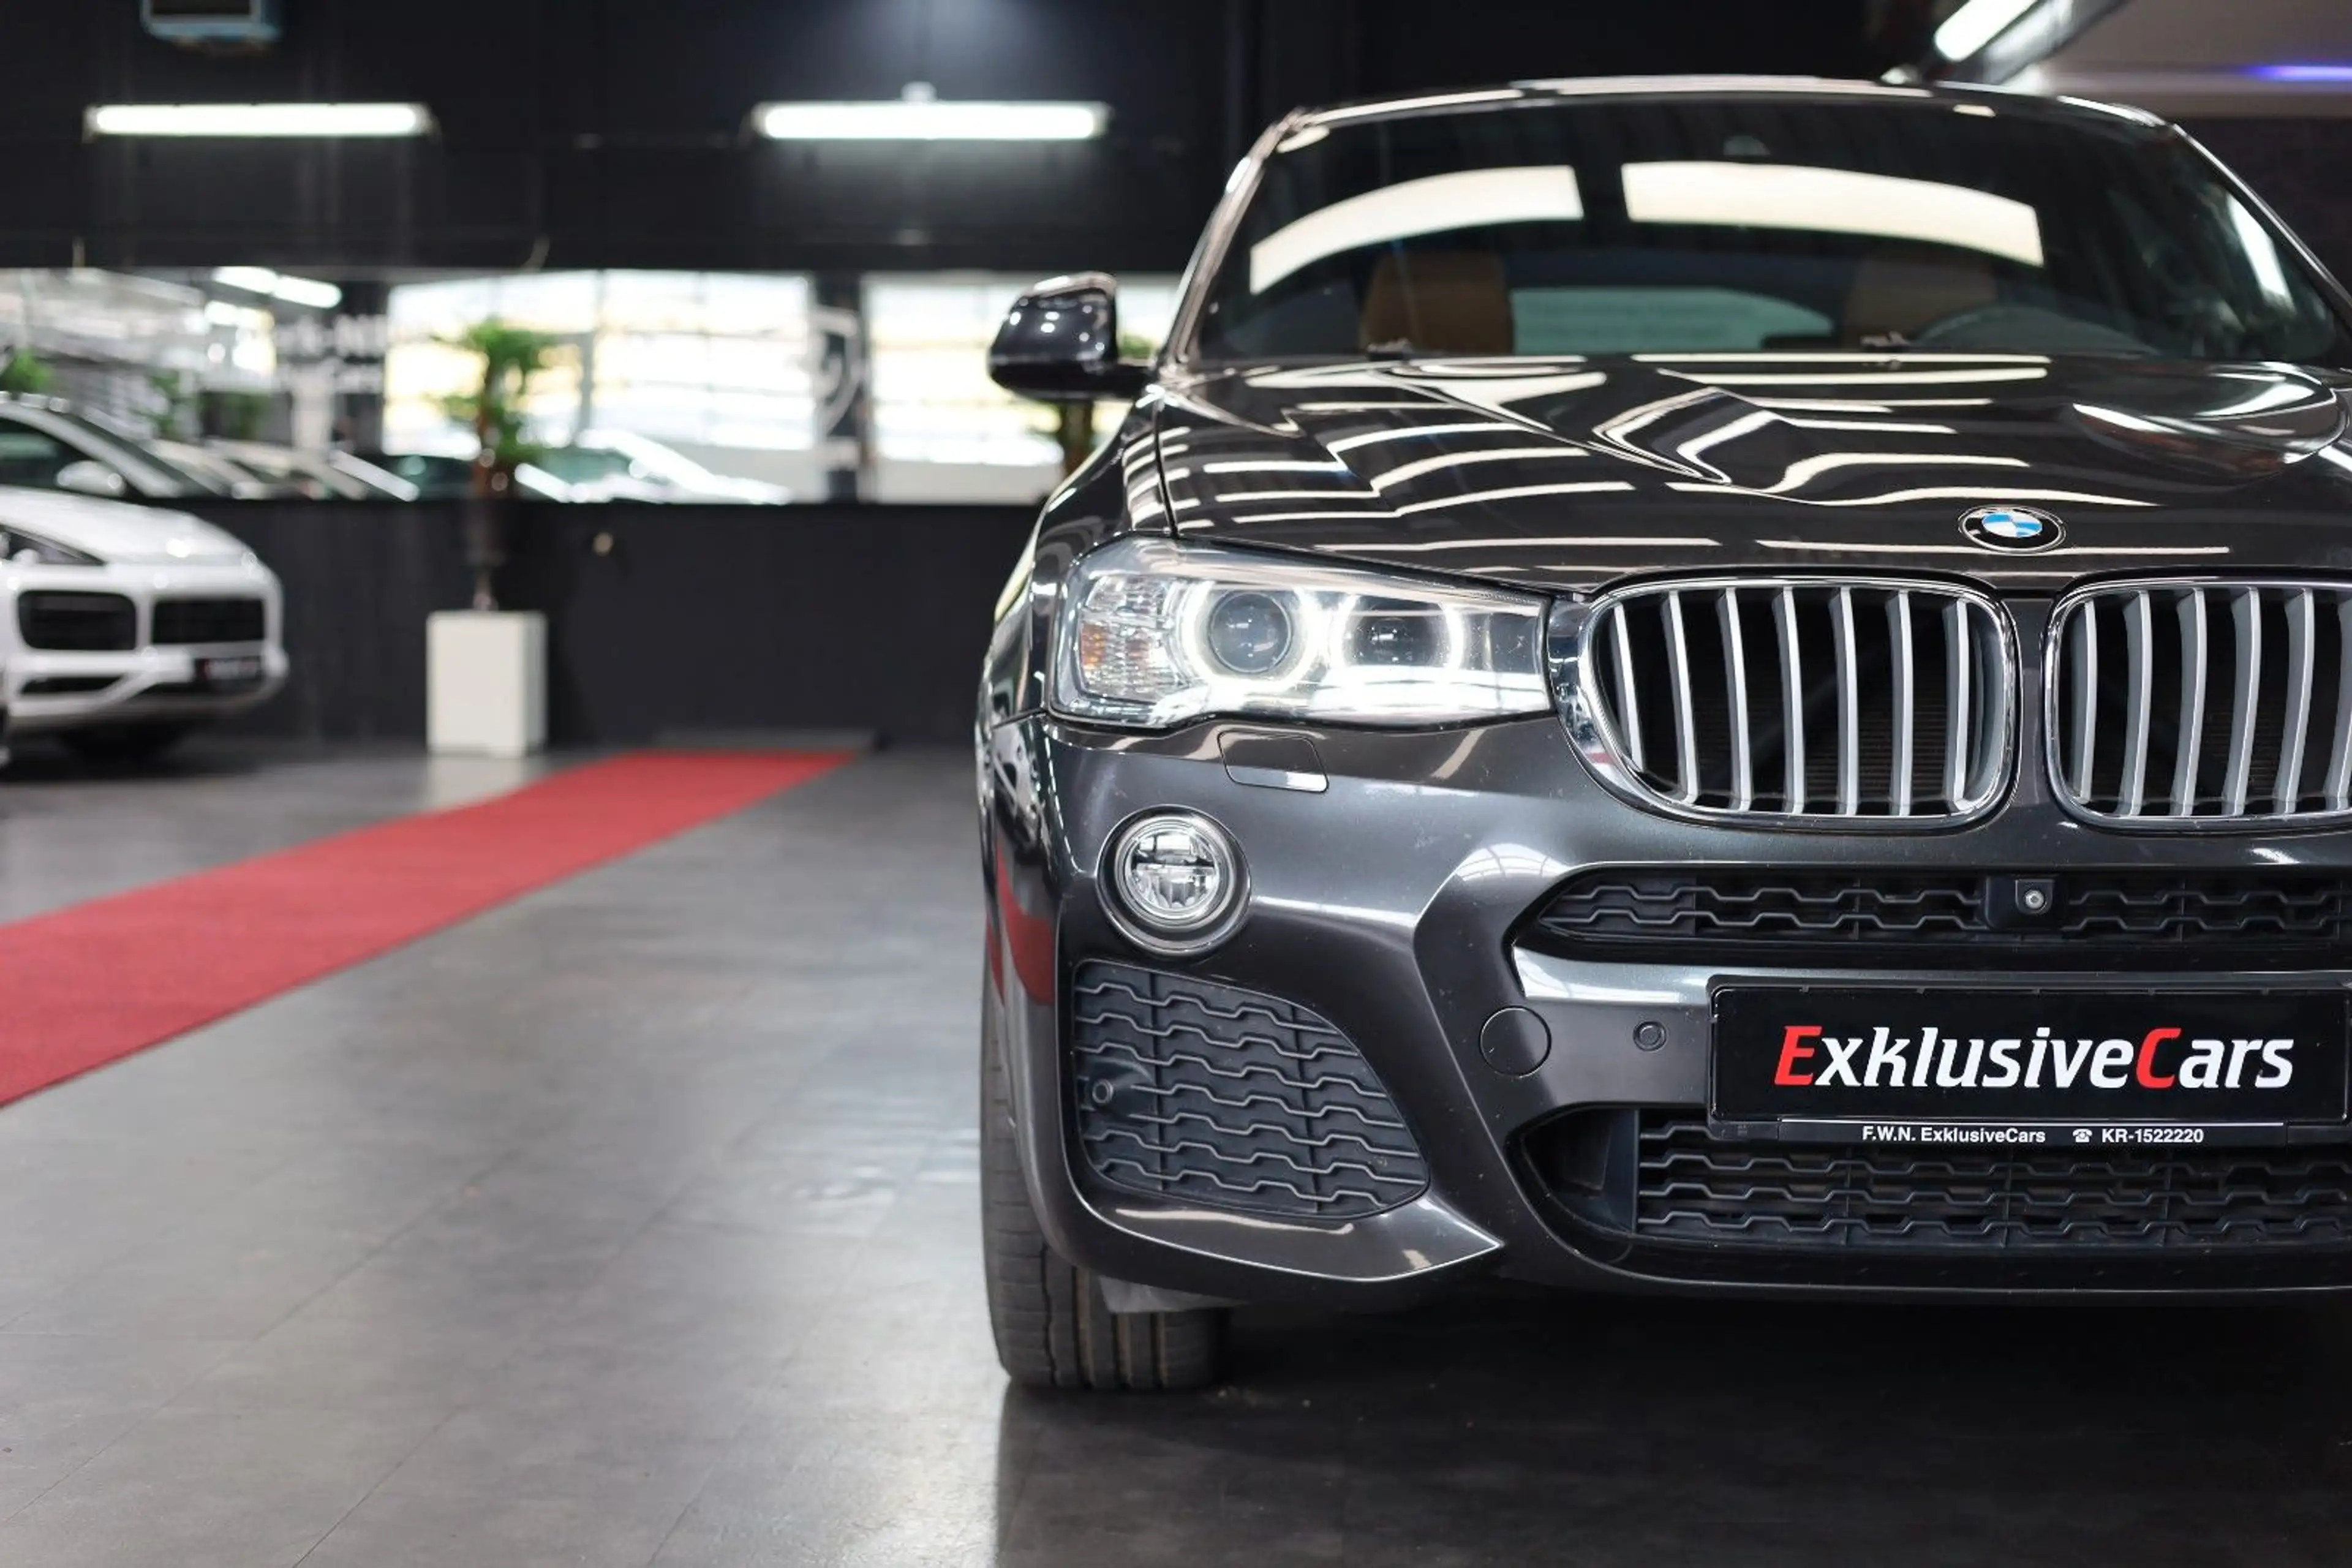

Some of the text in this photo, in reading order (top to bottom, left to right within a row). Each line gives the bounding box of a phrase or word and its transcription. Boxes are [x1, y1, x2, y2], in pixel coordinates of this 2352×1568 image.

[1774, 1025, 2294, 1088] ExklusiveCars
[1862, 1125, 2204, 1144] F.W.N. ExklusiveCars KR-1522220
